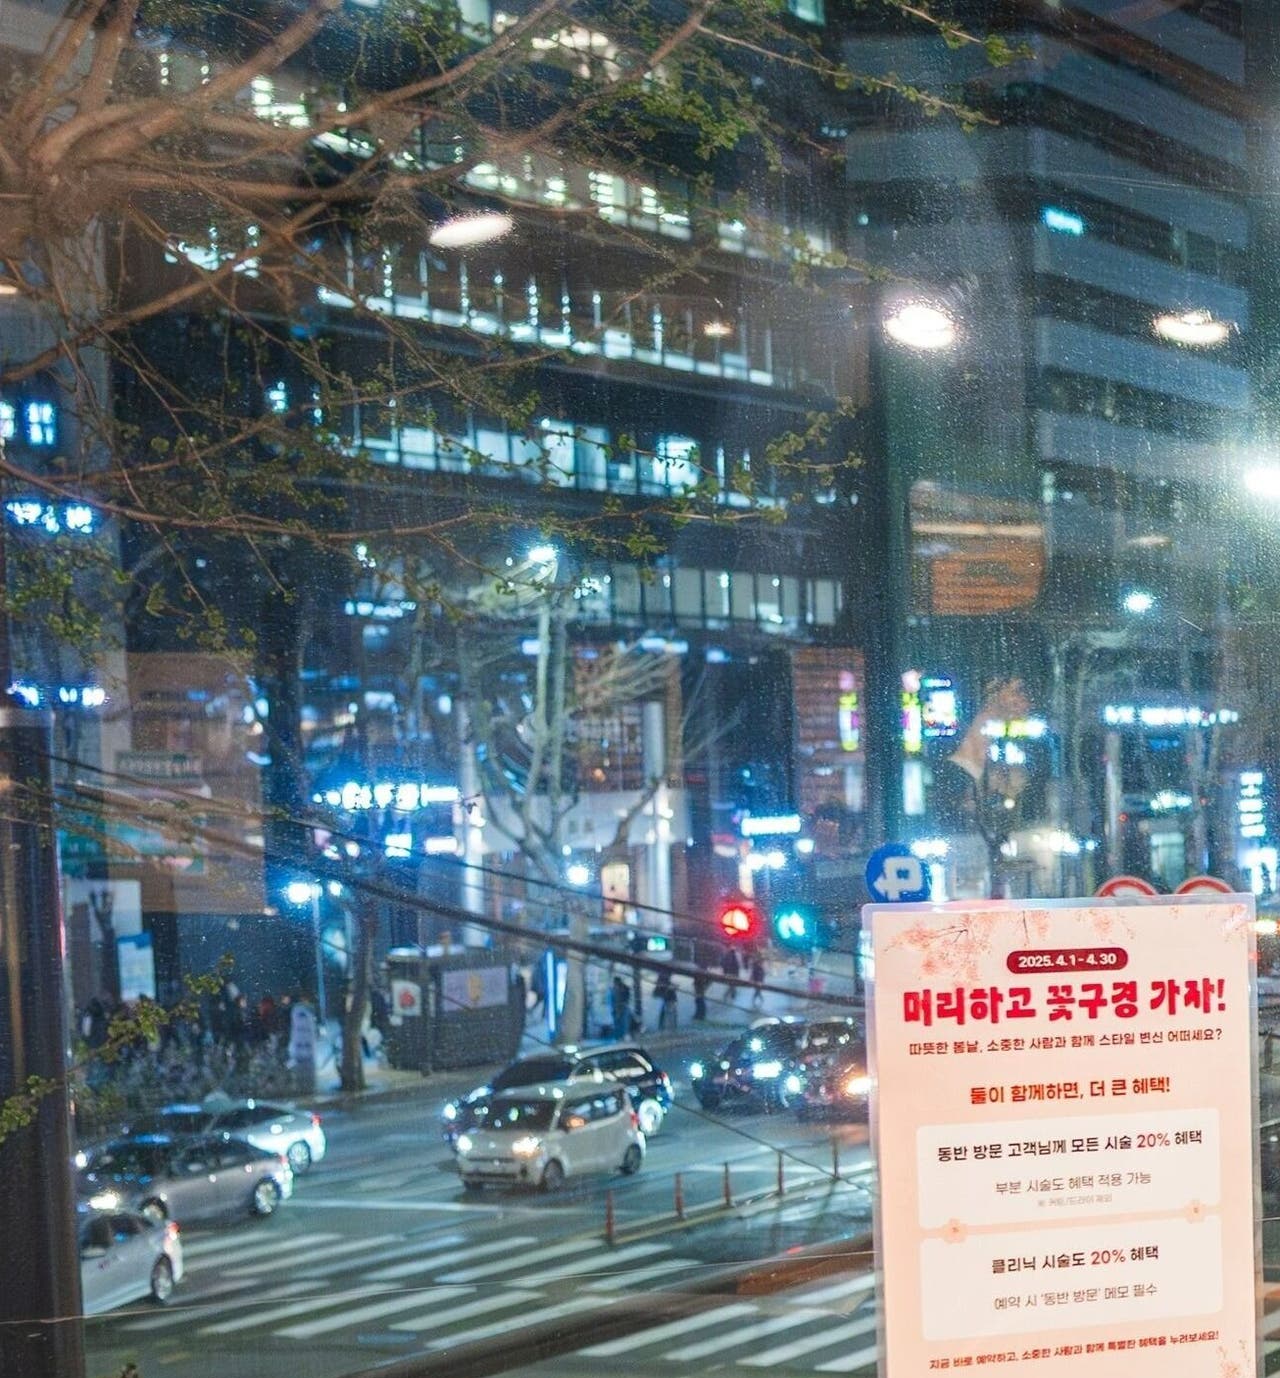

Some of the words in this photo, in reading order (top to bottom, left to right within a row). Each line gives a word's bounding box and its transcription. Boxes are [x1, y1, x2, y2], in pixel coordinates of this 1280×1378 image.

[903, 986, 1036, 1026] 머리하고
[1046, 981, 1139, 1022] 꽃구경
[1150, 978, 1226, 1016] 가자!
[909, 1042, 948, 1055] 따뜻한
[953, 1040, 983, 1054] 봄날,
[987, 1038, 1025, 1052] 소중한
[1029, 1036, 1066, 1050] 사람과
[1071, 1034, 1095, 1048] 함께
[1099, 1032, 1135, 1046] 스타일
[1140, 1031, 1163, 1044] 변신
[1167, 1028, 1222, 1042] 어떠세요?
[970, 1086, 1004, 1105] 둘이
[1010, 1081, 1084, 1102] 함께하면,
[1090, 1080, 1105, 1097] 더
[1111, 1079, 1127, 1096] 큰
[1132, 1076, 1171, 1094] 혜택!
[938, 1146, 968, 1162] 동반
[973, 1144, 1002, 1160] 방문
[1008, 1139, 1067, 1157] 고객님께
[1071, 1136, 1099, 1153] 모든
[1104, 1135, 1132, 1150] 시술
[1136, 1132, 1171, 1148] 20%
[1174, 1130, 1202, 1145] 혜택
[995, 1181, 1022, 1195] 부분
[1026, 1178, 1064, 1192] 시술도
[1068, 1175, 1094, 1190] 혜택
[1098, 1173, 1122, 1187] 적용
[1127, 1172, 1152, 1185] 가능
[992, 1256, 1036, 1274] 클리닉
[1042, 1251, 1086, 1269] 시술도
[1090, 1249, 1126, 1266] 20%
[1130, 1245, 1159, 1262] 혜택
[994, 1296, 1021, 1311] 예약
[1025, 1295, 1037, 1308] 시
[1104, 1285, 1129, 1300] 메모
[1133, 1282, 1158, 1297] 필수
